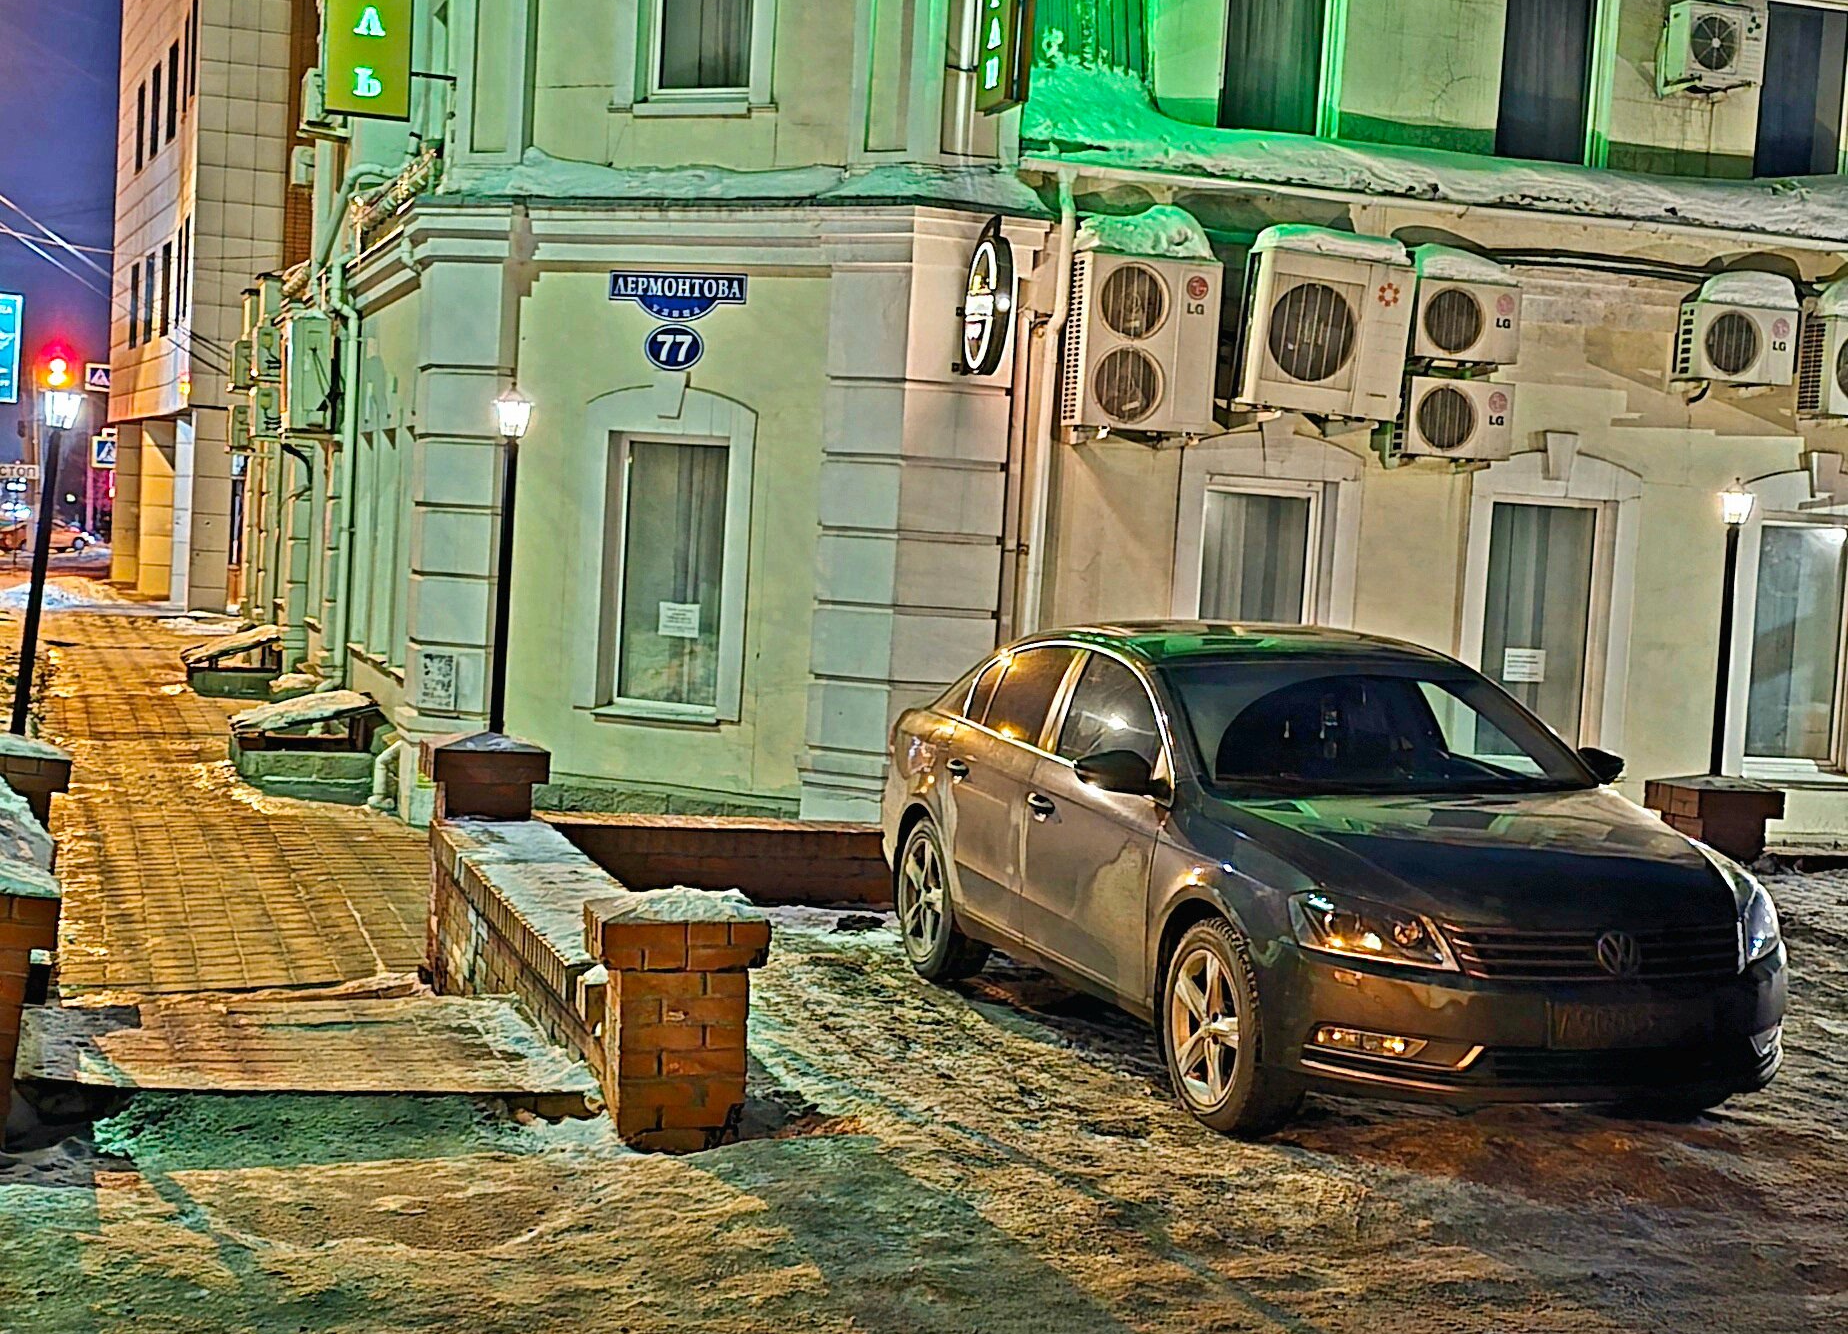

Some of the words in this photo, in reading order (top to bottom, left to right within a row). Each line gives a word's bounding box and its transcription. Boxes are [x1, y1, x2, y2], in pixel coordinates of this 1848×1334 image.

[614, 276, 741, 298] ЛЕРМОНТОВА
[1187, 302, 1205, 315] LG
[1495, 317, 1511, 330] LG
[656, 334, 693, 362] 77
[1772, 341, 1787, 352] LG
[1488, 415, 1504, 427] LG
